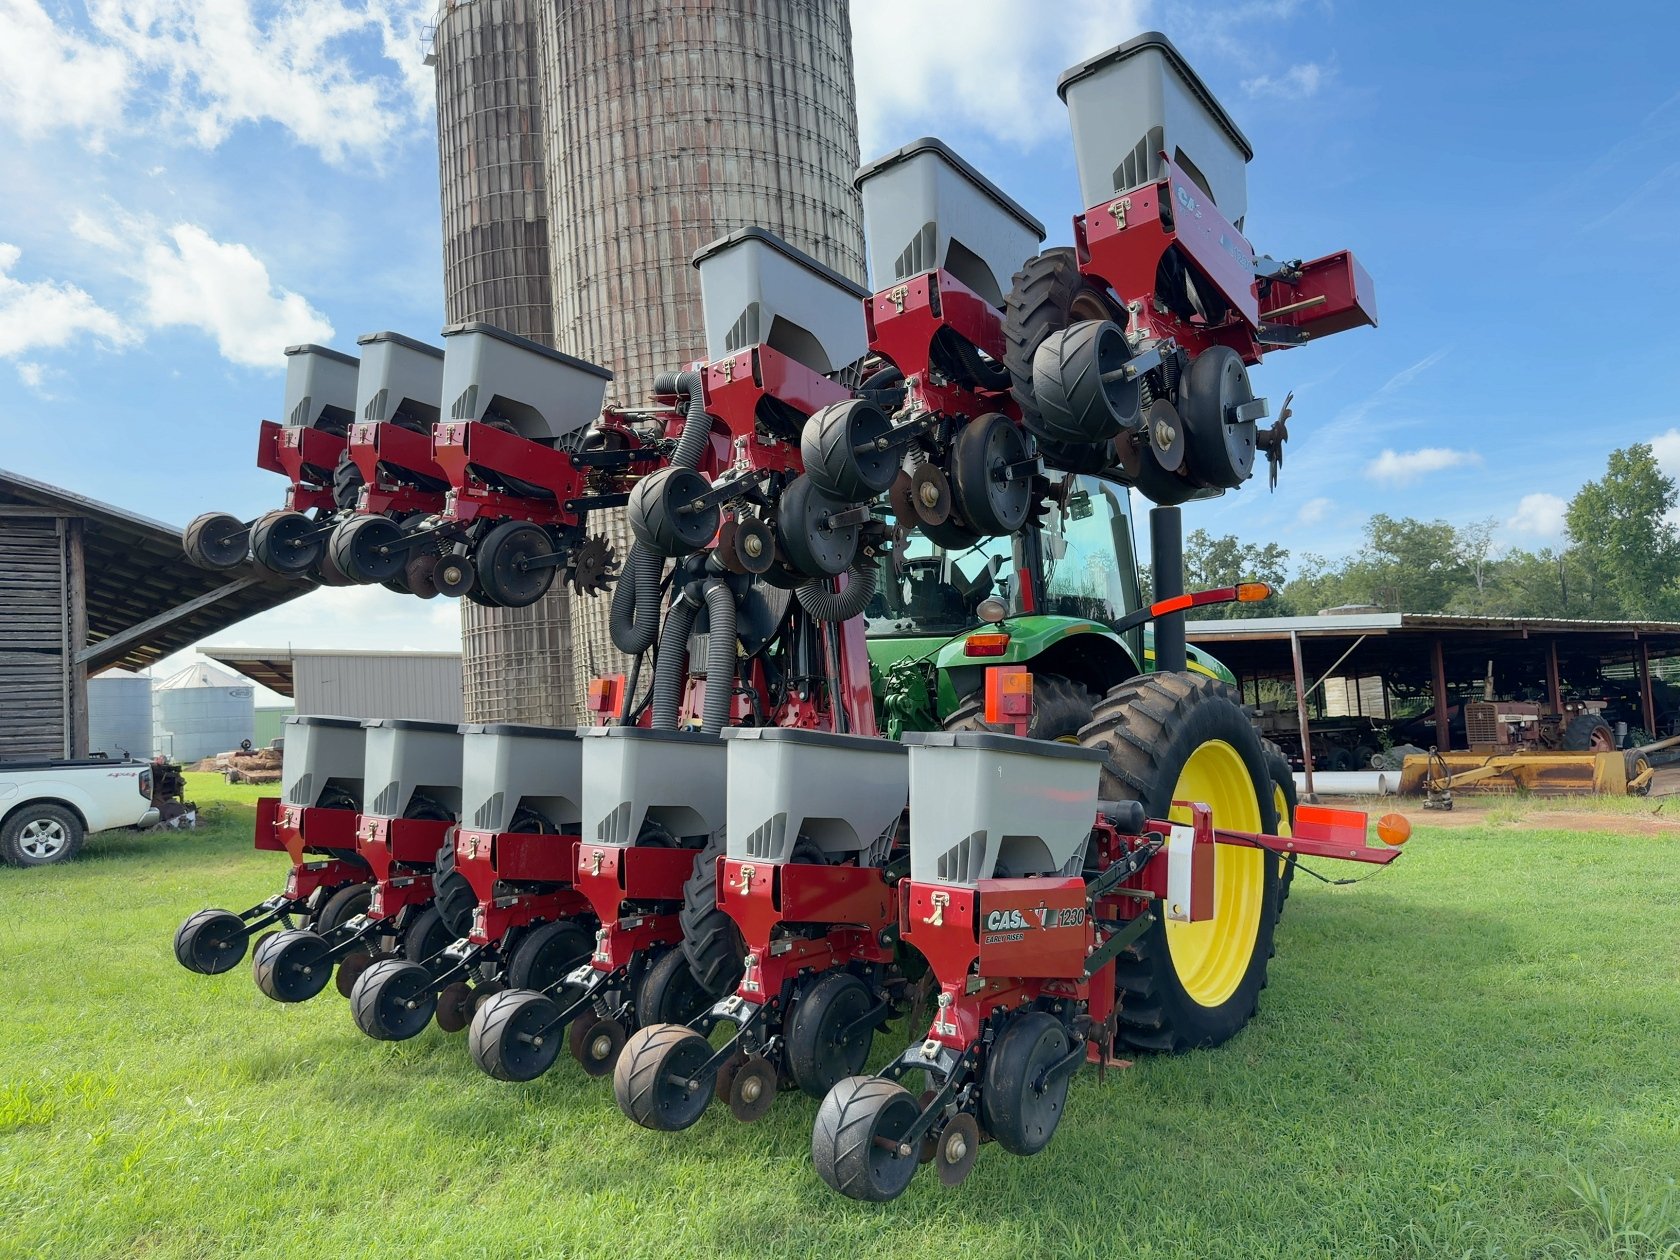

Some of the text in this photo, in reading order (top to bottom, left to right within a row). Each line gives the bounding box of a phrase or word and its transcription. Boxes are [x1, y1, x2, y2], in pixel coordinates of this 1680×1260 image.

[1060, 907, 1085, 928] 1230
[985, 933, 1024, 944] EARLY RISER
